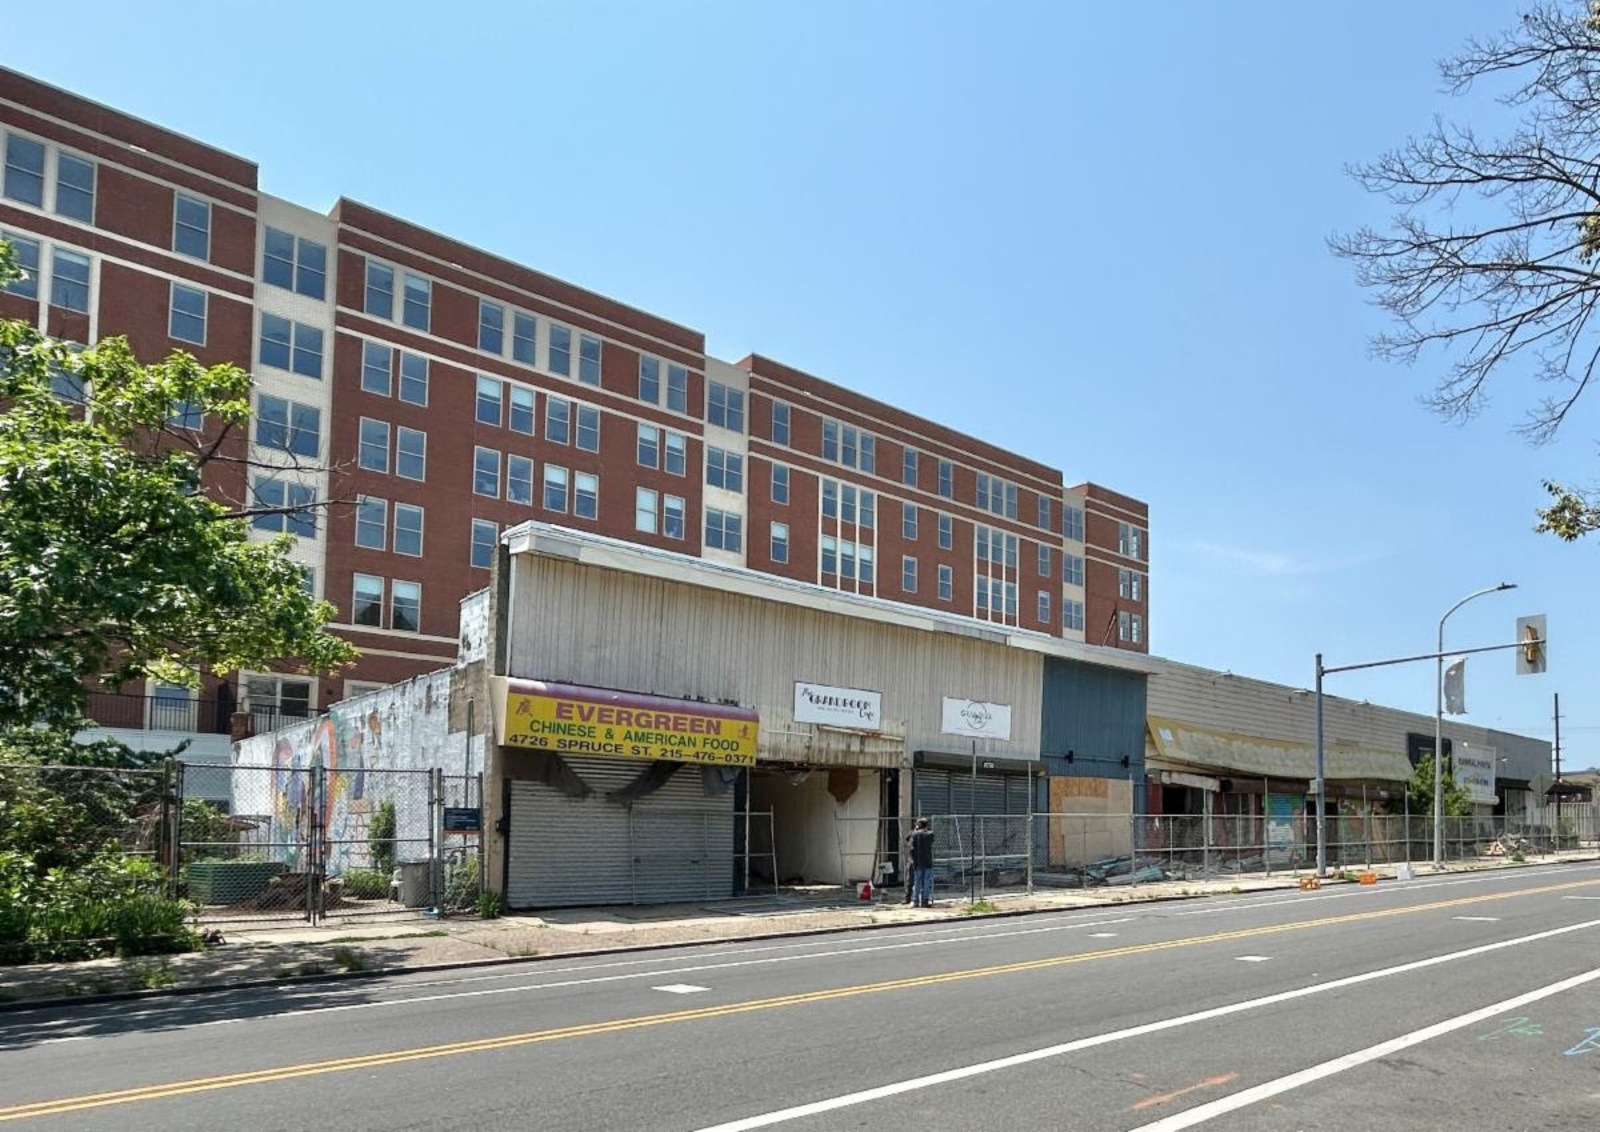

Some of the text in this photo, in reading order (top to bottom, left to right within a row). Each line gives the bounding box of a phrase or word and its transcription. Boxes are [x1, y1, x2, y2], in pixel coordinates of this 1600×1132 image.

[556, 702, 722, 735] EVERGREEN
[509, 734, 754, 764] 4726 SPRUCE ST. 215-476-0371
[530, 720, 739, 751] CHINESE & AMERICAN FOOD
